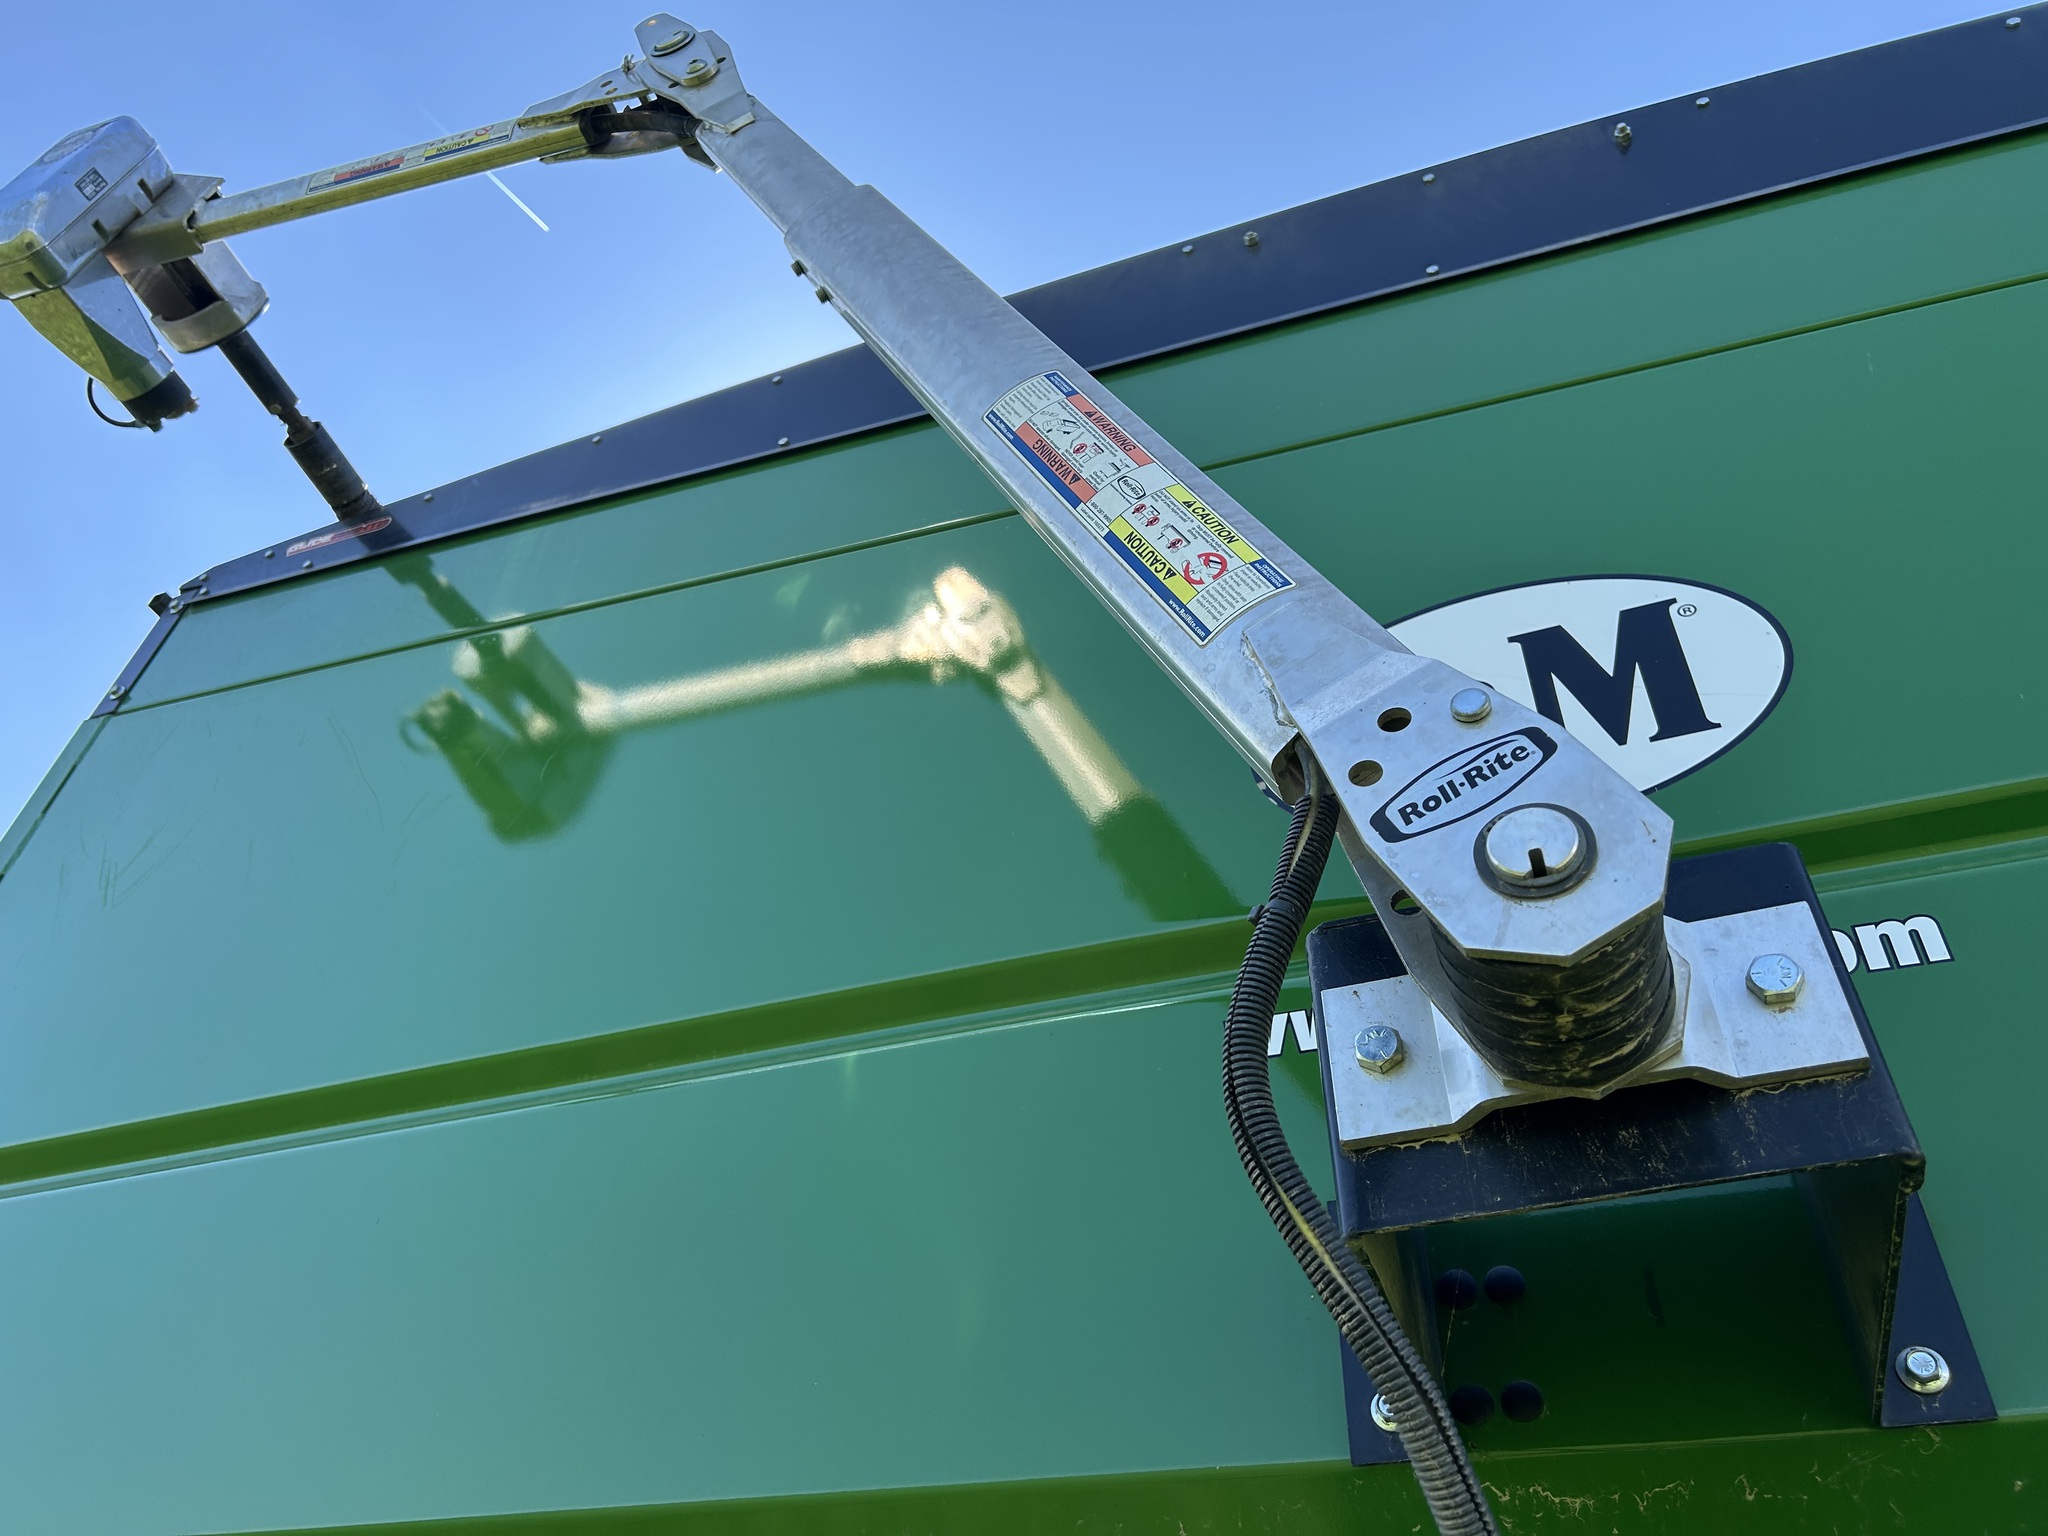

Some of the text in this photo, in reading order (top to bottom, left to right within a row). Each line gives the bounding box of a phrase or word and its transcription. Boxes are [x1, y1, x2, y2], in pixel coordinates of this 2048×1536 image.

[1092, 415, 1136, 452] WARNING
[1030, 437, 1073, 480] WARNING
[1191, 505, 1239, 545] CAUTION
[1122, 530, 1167, 574] CAUTION
